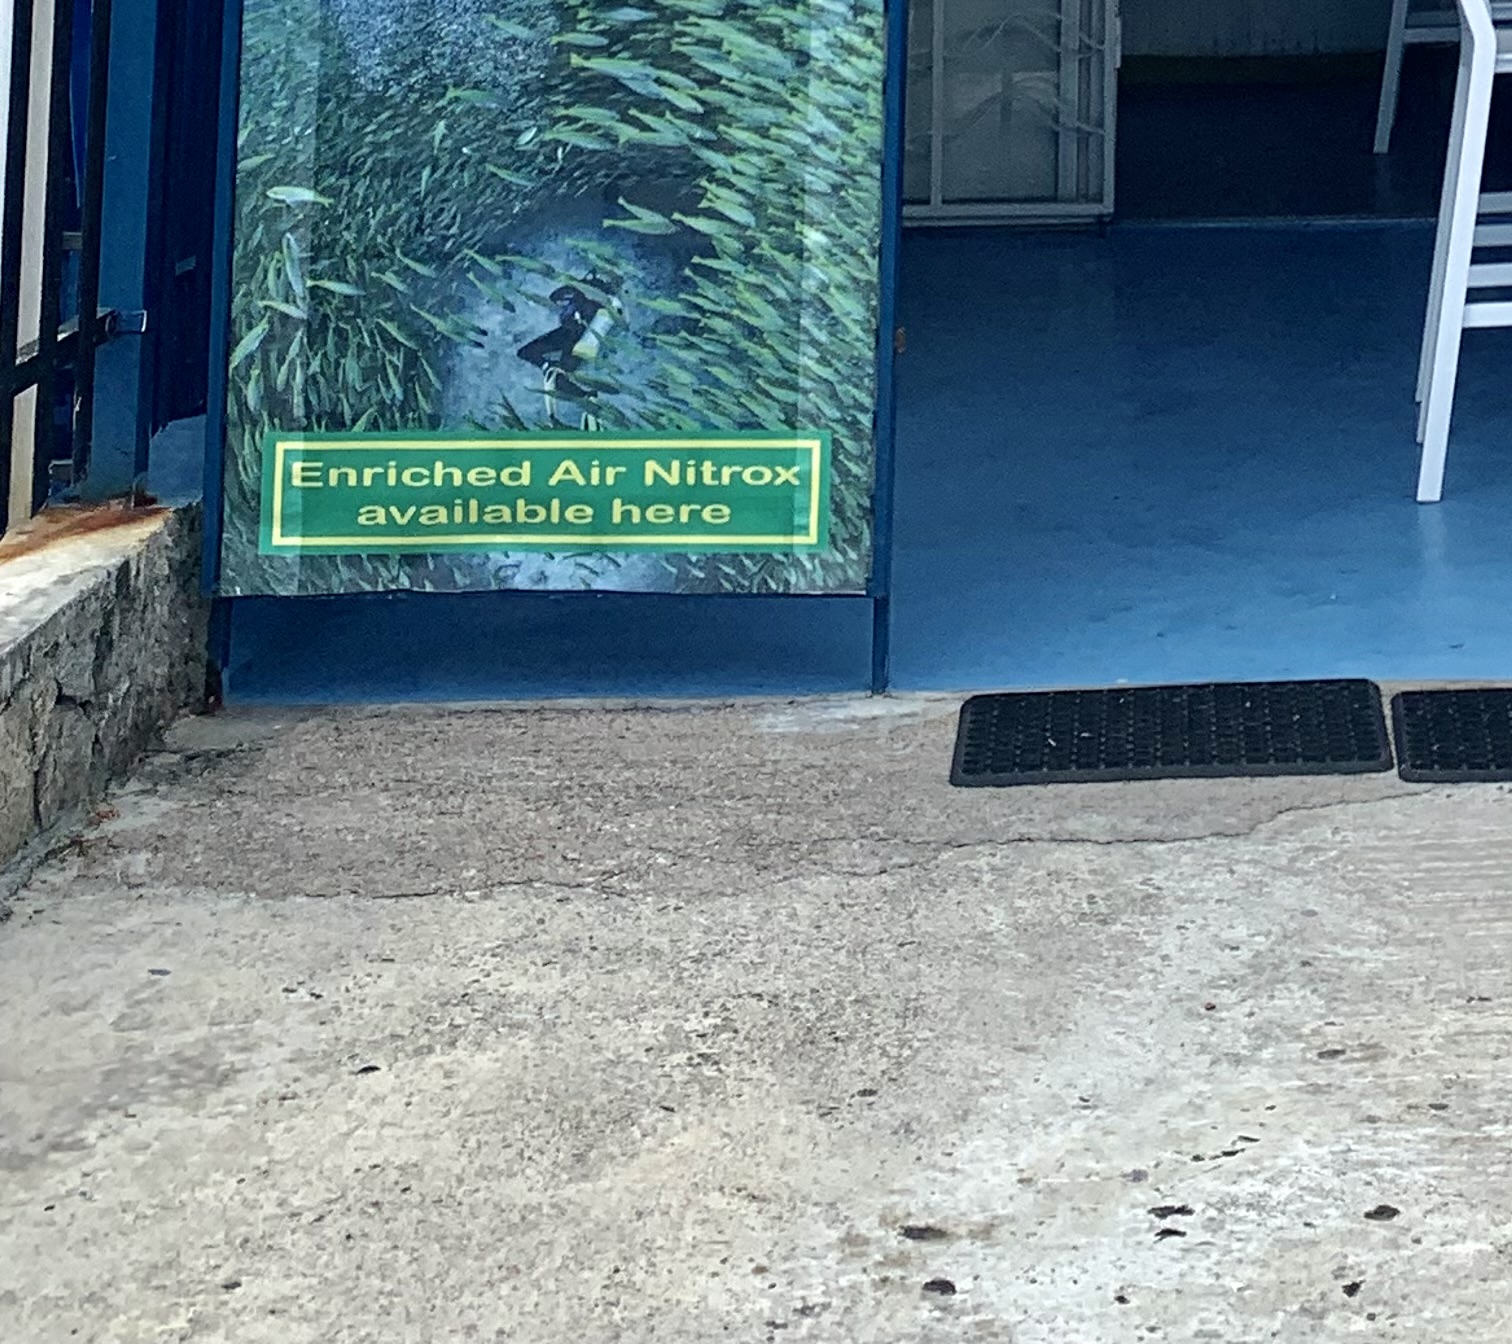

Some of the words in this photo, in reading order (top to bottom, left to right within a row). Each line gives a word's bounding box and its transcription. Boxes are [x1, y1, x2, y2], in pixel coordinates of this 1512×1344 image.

[290, 459, 531, 488] Enriched
[548, 459, 627, 487] Air
[645, 459, 800, 487] Nitrox
[357, 497, 593, 526] available
[612, 499, 732, 525] here
